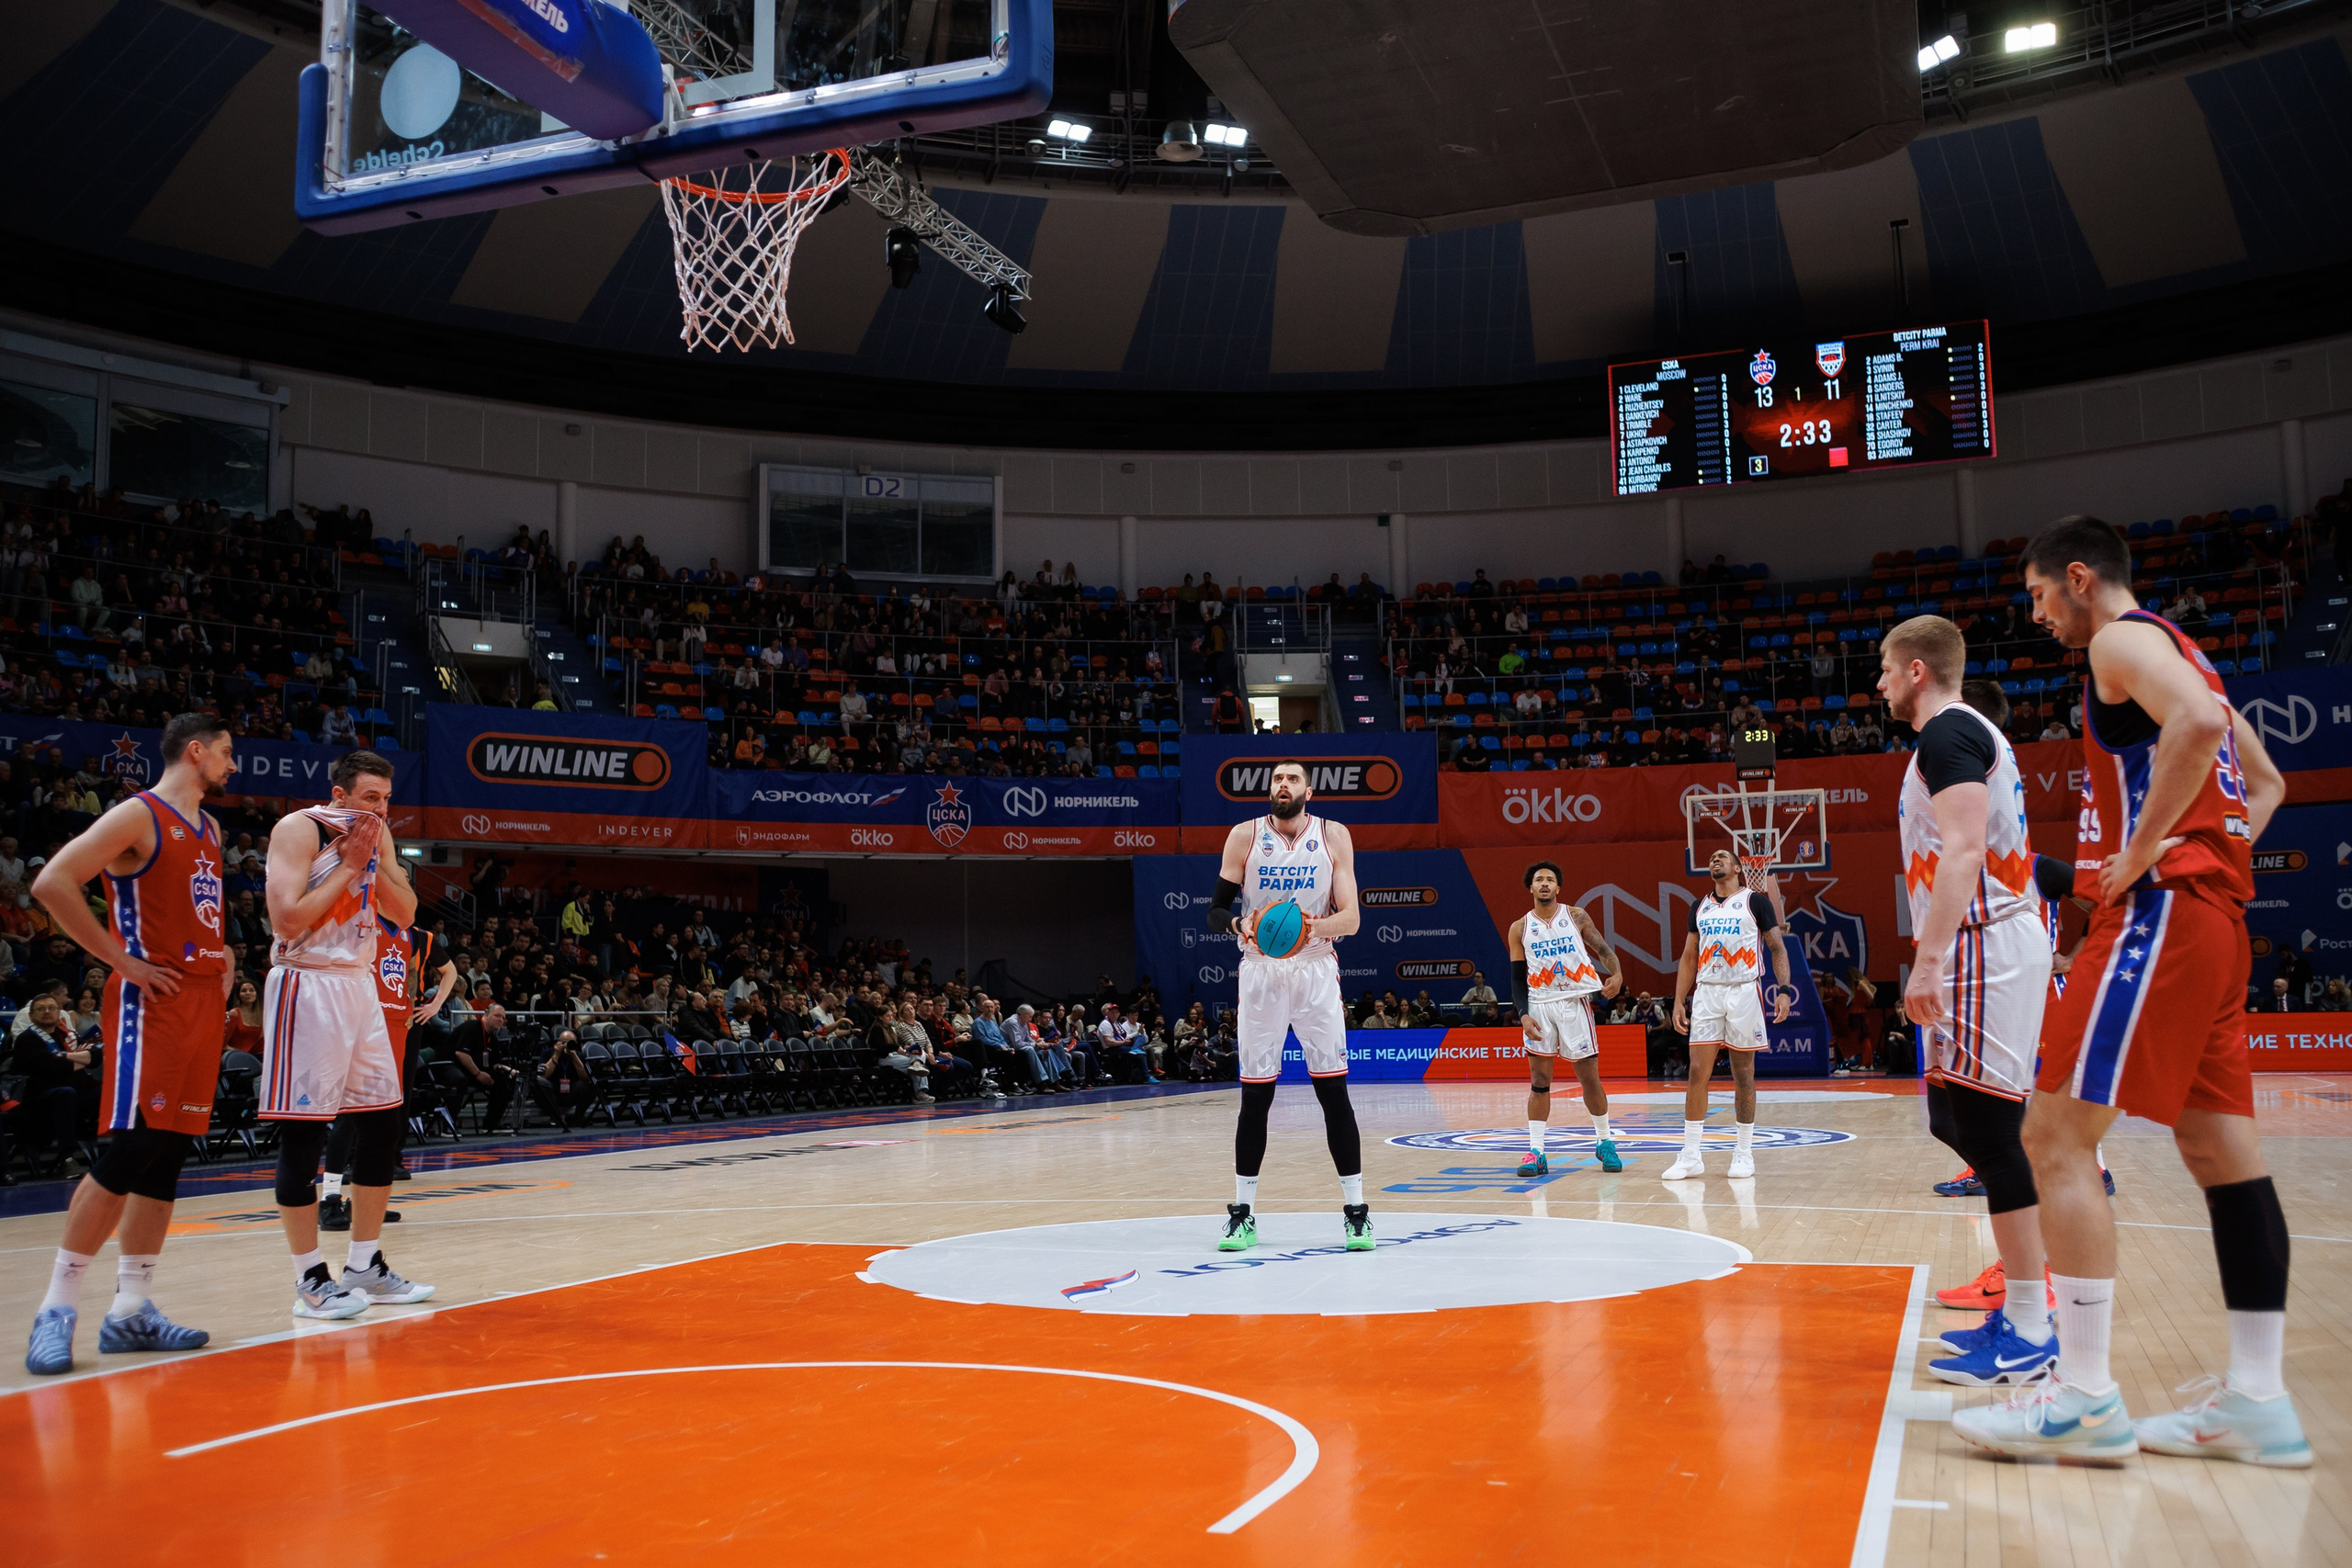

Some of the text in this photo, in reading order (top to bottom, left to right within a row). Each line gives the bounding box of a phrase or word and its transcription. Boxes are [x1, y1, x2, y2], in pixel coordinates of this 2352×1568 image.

[1894, 327, 1947, 342] BETCITY PARMA
[1900, 338, 1939, 352] PERM KRAI
[1866, 356, 1871, 366] 2
[1872, 354, 1895, 365] ADAMS
[1978, 343, 1983, 352] 2
[1662, 360, 1679, 370] CSKA
[1867, 353, 1984, 375] 3 SVININ 0
[1657, 369, 1686, 381] MOSCOW
[1867, 376, 1871, 384] 4
[1873, 373, 1896, 383] ADAMS
[1979, 362, 1984, 371] 3
[1624, 382, 1658, 394] CLEVELAND
[1722, 374, 1726, 382] 0
[1824, 378, 1839, 400] 11
[1874, 381, 1904, 392] SANDERS
[1980, 371, 1984, 380] 0
[1624, 393, 1642, 402] WARE
[1722, 383, 1727, 391] 4
[1755, 386, 1773, 408] 13
[1795, 387, 1801, 400] 1
[1866, 381, 1985, 403] 11 ILNITSKIY 3
[1625, 400, 1664, 412] RUZHENTSEV
[1723, 392, 1727, 401] 0
[1865, 391, 1986, 412] 14 MINCHENKO 0
[1619, 401, 1727, 422] 5 GANKEVICH 0
[1876, 410, 1904, 421] STAFEEV
[1982, 400, 1986, 409] 0
[1626, 420, 1652, 430] TRIMBLE
[1724, 411, 1728, 419] 0
[1866, 410, 1987, 432] 32 CARTER 0
[1626, 429, 1646, 439] UKHOV
[1780, 419, 1831, 447] 2:33
[1877, 428, 1911, 440] SHASHKOV
[1983, 420, 1988, 428] 3
[1626, 435, 1668, 448] ASTAPKOVICH
[1724, 429, 1729, 437] 0
[1867, 429, 1988, 450] 70 EGOROV 0
[1627, 446, 1659, 457] KARPENKO
[1724, 438, 1730, 446] 0
[1878, 446, 1913, 459] ZAKHAROV
[1984, 439, 1989, 448] 0
[1619, 457, 1731, 476] 17 JEAN CHARLES 0
[1627, 456, 1656, 467] ANTONOV
[1755, 458, 1762, 472] 3
[1628, 473, 1661, 485] KURBANOV
[1726, 466, 1731, 474] 3
[865, 478, 900, 497] D2
[1619, 476, 1731, 495] 99 MITROVIC 2
[1746, 729, 1769, 742] 2:33
[113, 761, 144, 775] СКА
[485, 743, 628, 778] WINLINE
[1231, 766, 1362, 792] WIINE
[752, 790, 873, 805] АЭРОФЛОТ
[1055, 796, 1139, 807] НОРНИКЕЛЬ
[933, 808, 967, 821] ЦСКА
[495, 821, 551, 832] НОРНИКЕЛЬ
[598, 825, 673, 838] INDEVER
[2078, 807, 2102, 843] 99
[752, 832, 809, 841] ЭНДОФАРМ
[2249, 856, 2285, 869] LINE
[1258, 865, 1317, 876] BETCITY
[1259, 877, 1314, 890] PARMA
[1365, 891, 1421, 904] WINLINE
[2244, 900, 2290, 908] НИКЕЛЬ
[1699, 919, 1742, 927] BETCITY
[1702, 926, 1740, 935] PARMA
[1199, 934, 1237, 942] ЭНДОФ
[1406, 929, 1457, 937] НОРНИКЕЛЬ
[1531, 936, 1573, 950] BETCITY
[1713, 941, 1723, 957] 2
[1804, 931, 1850, 959] КА
[1534, 944, 1577, 958] PARMA
[384, 963, 404, 973] CSKA
[1340, 968, 1377, 976] елеком
[1402, 964, 1458, 976] WINLINE
[1553, 960, 1566, 976] 4
[397, 983, 403, 998] 6
[1375, 1047, 1489, 1061] МЕДИЦИНСКИЕ
[180, 1103, 211, 1112] WINLINE
